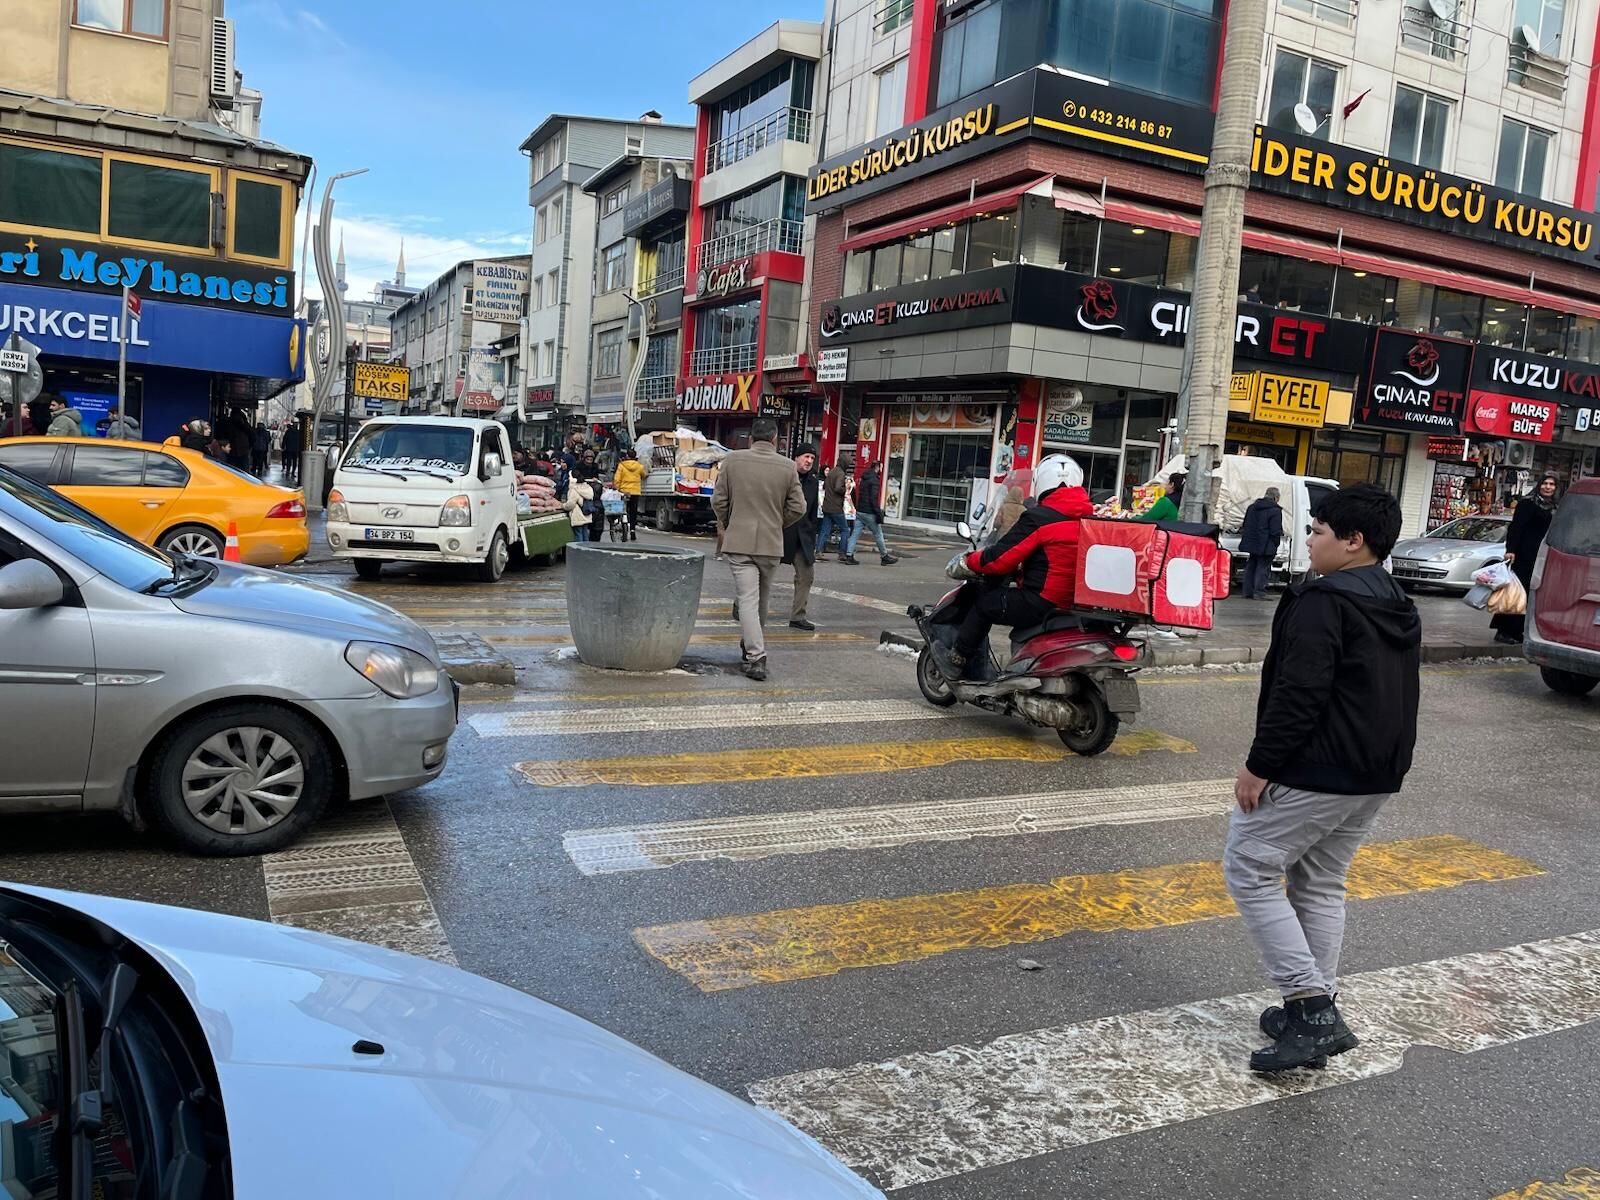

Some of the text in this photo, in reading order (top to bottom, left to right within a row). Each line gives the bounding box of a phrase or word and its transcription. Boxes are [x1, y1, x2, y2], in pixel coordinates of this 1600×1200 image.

[1079, 105, 1172, 139] 0 432 214 86 87
[808, 102, 993, 201] LİDER SÜRÜCÜ KURSU
[1251, 127, 1592, 251] İDER SÜRÜCÜ KURSU
[59, 248, 288, 308] Meyhanesi
[476, 265, 528, 280] KEBABİSTAN
[476, 290, 484, 298] ET
[841, 287, 1005, 329] ÇINAR ET KUZU KAVURMA
[1151, 301, 1325, 358] ÇIR ET
[357, 379, 406, 394] TAKSİ
[358, 370, 389, 379] KÖŞEM
[1492, 358, 1560, 390] KUZU
[1261, 378, 1320, 410] EYFEL
[1374, 384, 1463, 414] ÇINAR ET
[1378, 408, 1454, 427] KUZU KAVURMA
[1510, 402, 1550, 421] MARAŞ
[1513, 418, 1543, 436] BÜFE
[369, 530, 379, 539] 34
[399, 532, 413, 541] 154
